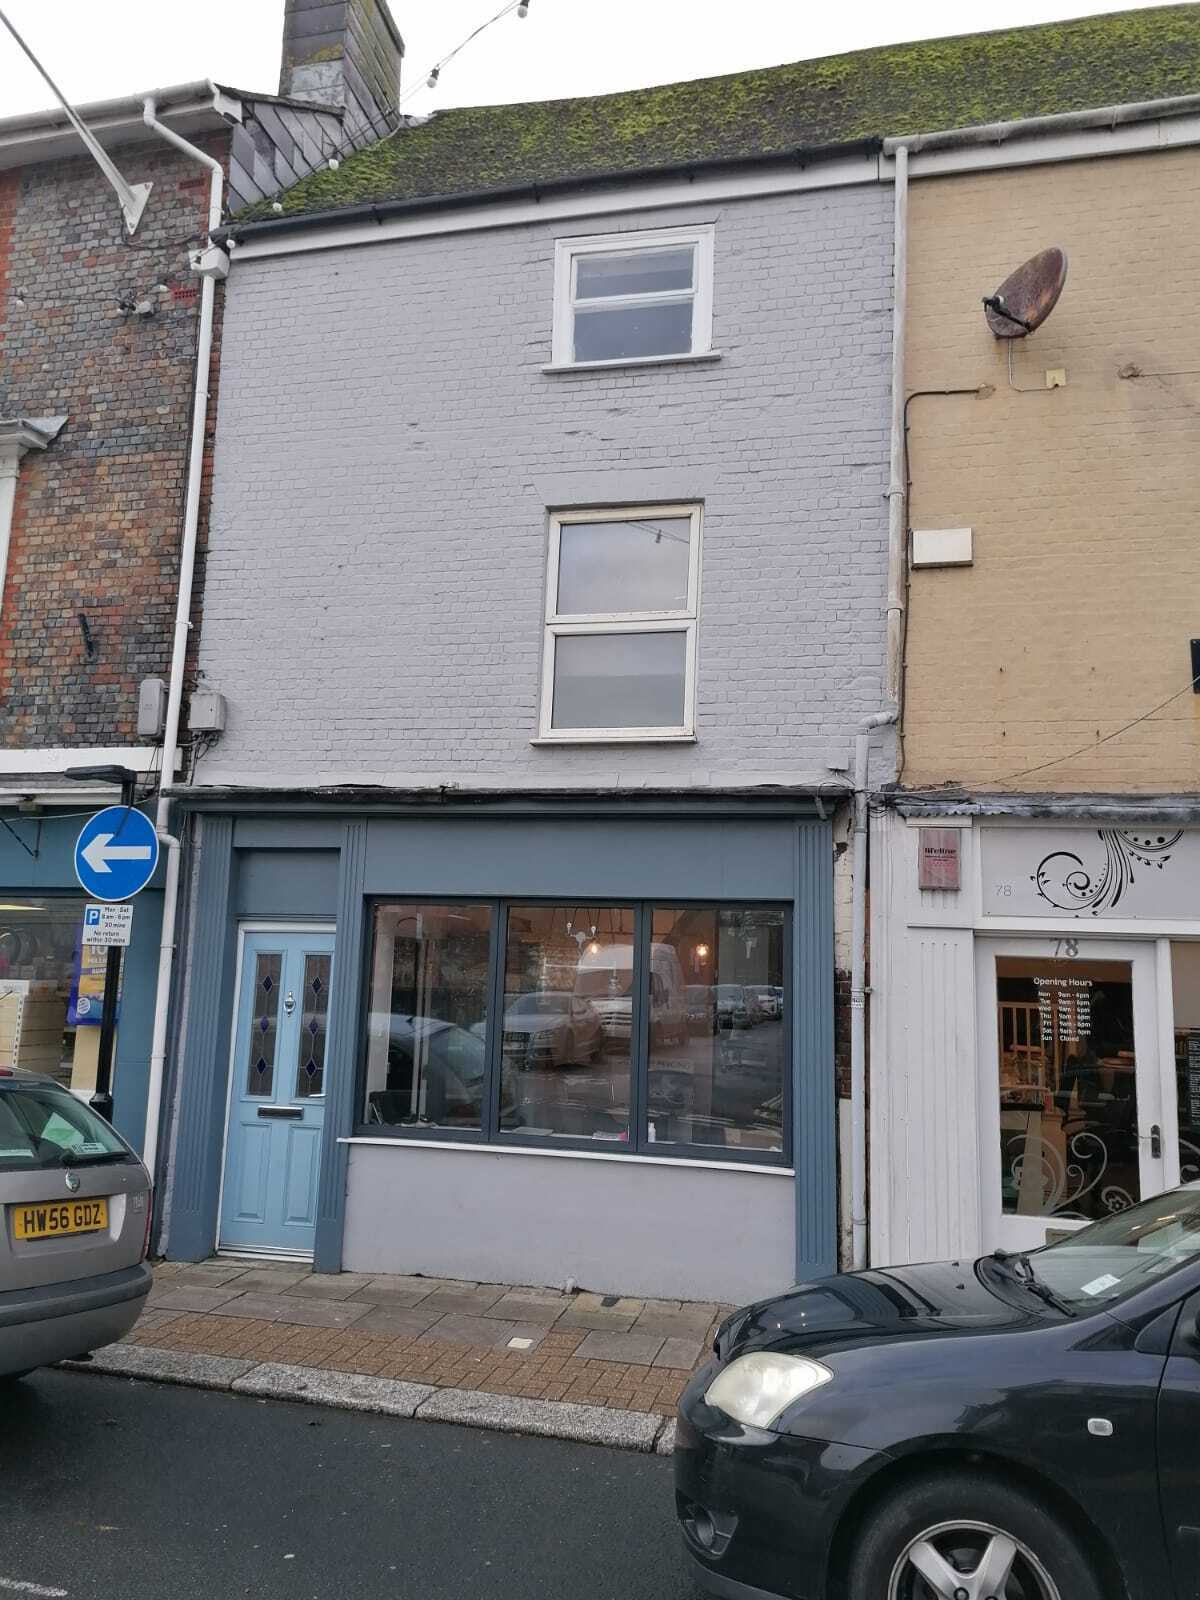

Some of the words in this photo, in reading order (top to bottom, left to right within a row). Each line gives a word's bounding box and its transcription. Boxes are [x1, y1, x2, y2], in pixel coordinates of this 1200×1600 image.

[995, 884, 1013, 897] 78
[1049, 937, 1079, 957] 78
[1033, 977, 1067, 987] Opening
[1068, 978, 1093, 987] Hours
[1059, 1034, 1080, 1042] Closed
[23, 1206, 70, 1234] HW56
[73, 1203, 102, 1228] GDZ
